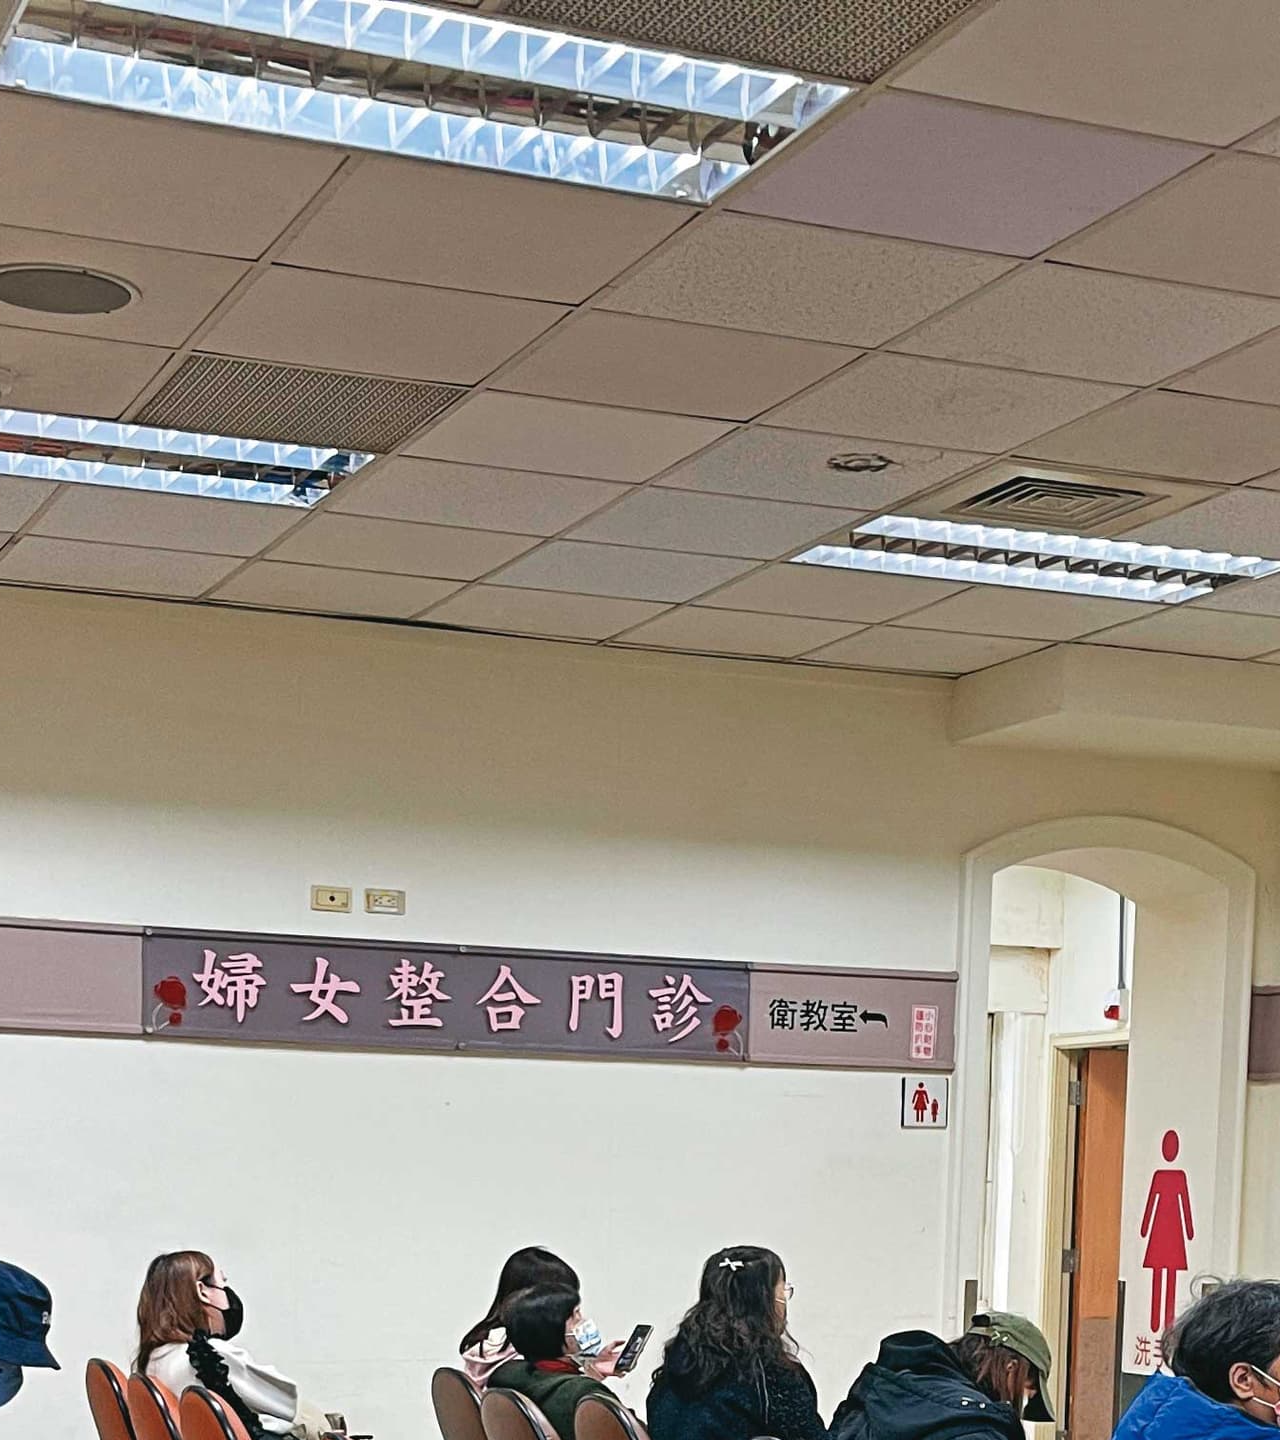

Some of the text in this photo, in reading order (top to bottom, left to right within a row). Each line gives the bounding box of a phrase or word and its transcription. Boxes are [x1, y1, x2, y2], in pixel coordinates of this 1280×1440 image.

[192, 949, 713, 1043] 婦女整合門診
[769, 998, 858, 1032] 衛教室
